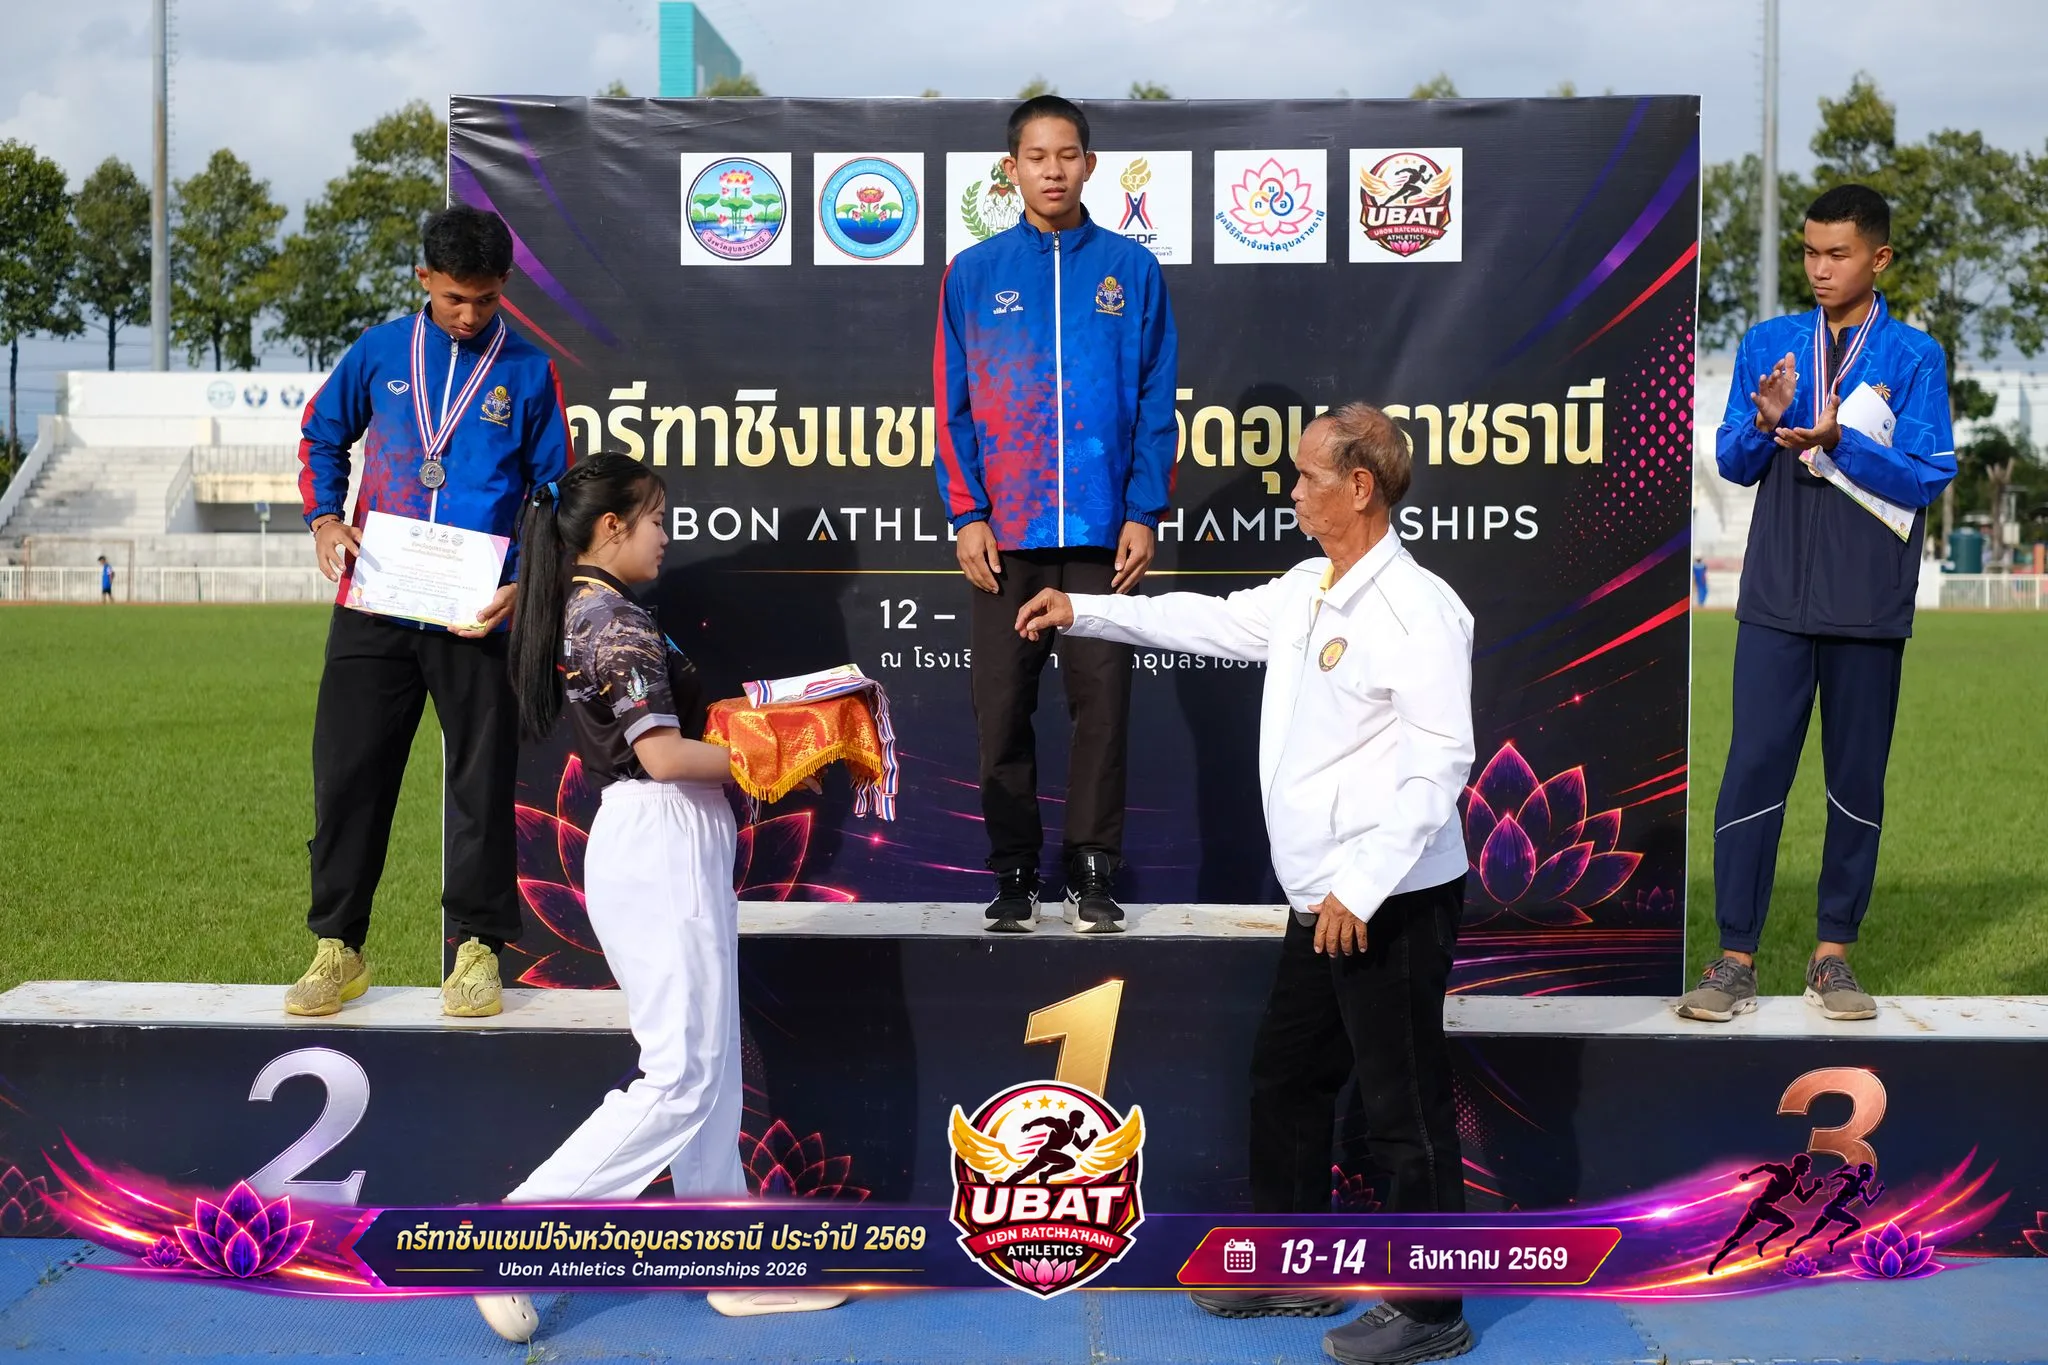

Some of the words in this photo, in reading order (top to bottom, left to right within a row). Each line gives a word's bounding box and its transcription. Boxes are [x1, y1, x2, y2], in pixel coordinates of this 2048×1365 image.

[1367, 206, 1444, 226] UBAT
[1374, 227, 1394, 237] UBON
[673, 506, 779, 542] BON
[880, 599, 917, 629] 12
[881, 652, 902, 668] ณ
[1024, 979, 1124, 1099] 1
[247, 1047, 371, 1207] 2
[1777, 1066, 1887, 1208] 3
